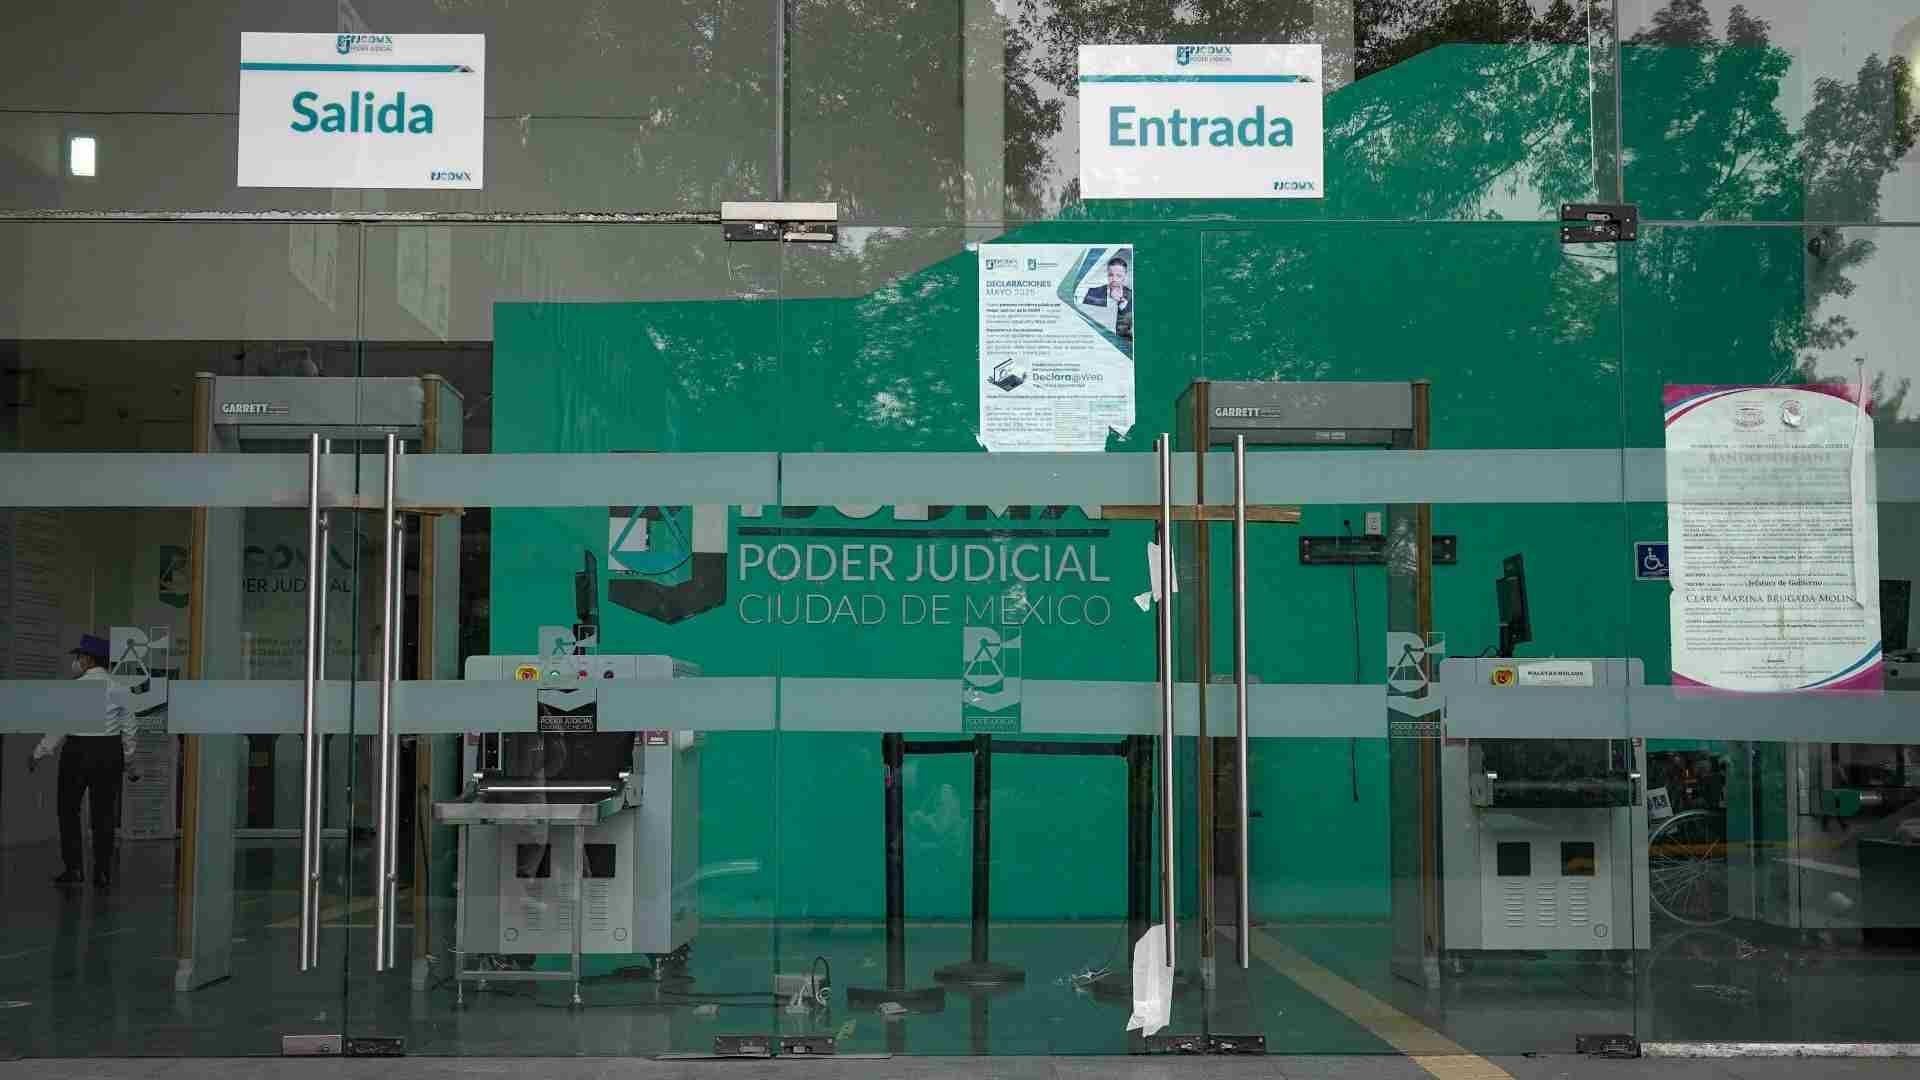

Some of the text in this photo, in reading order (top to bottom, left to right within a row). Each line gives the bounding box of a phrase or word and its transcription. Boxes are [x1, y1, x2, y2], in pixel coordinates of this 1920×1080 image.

[290, 91, 433, 134] Salida
[1109, 105, 1293, 147] Entrada
[222, 403, 268, 413] GARRETT
[1215, 407, 1260, 417] GARRETT
[739, 543, 1111, 582] PODER JUDICIAL
[739, 594, 886, 625] CIUDAD
[902, 595, 951, 625] DE
